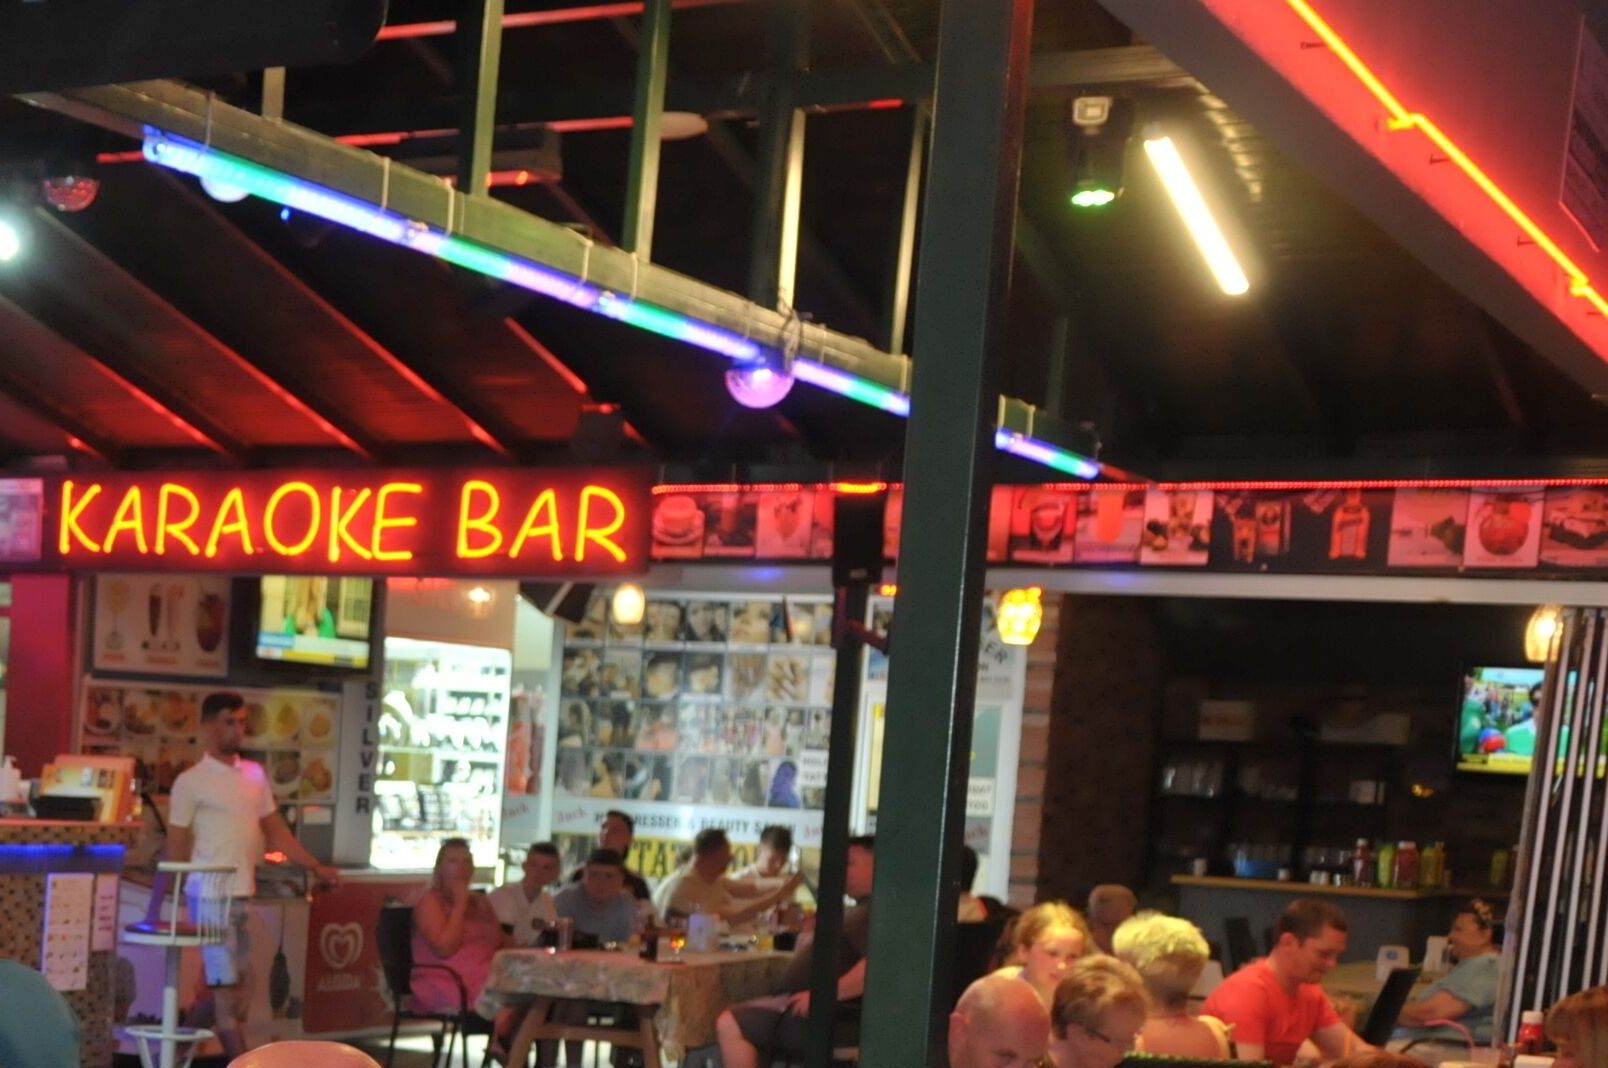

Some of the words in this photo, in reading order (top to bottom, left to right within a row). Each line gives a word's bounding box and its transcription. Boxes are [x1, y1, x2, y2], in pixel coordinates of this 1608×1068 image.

[59, 479, 423, 563] KARAOKE
[456, 479, 628, 563] BAR
[356, 682, 377, 814] SILVER
